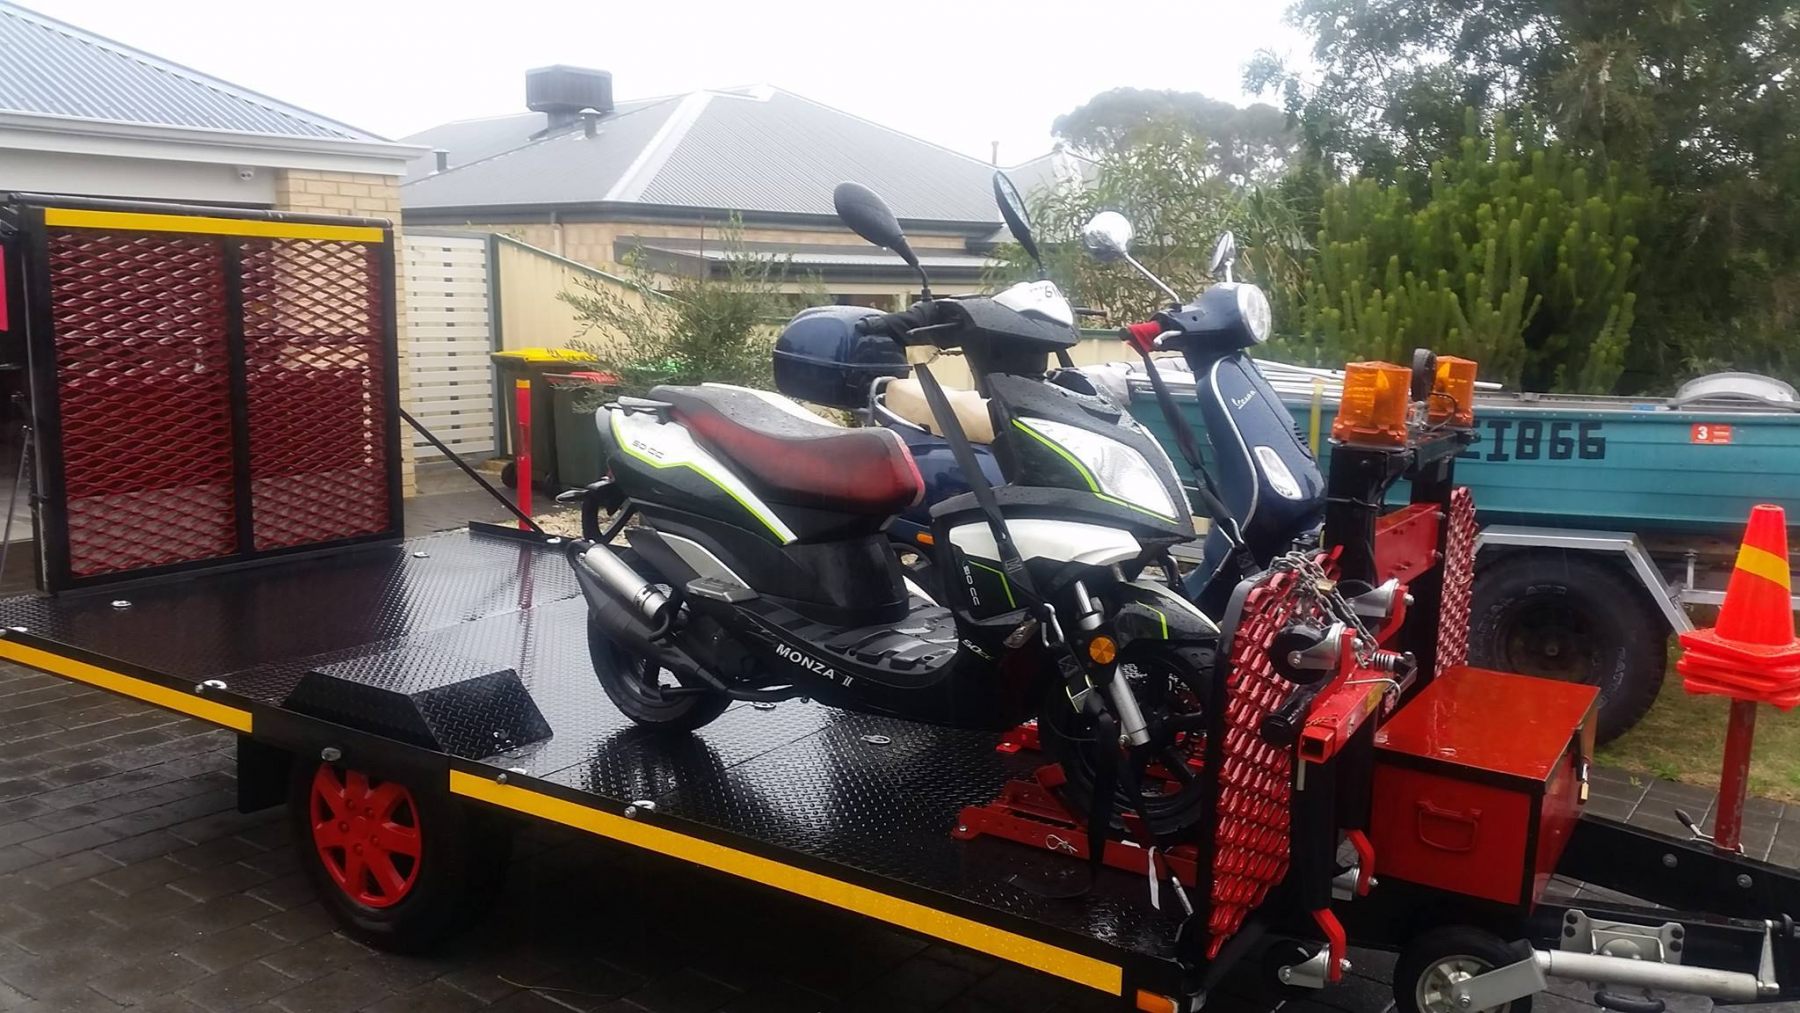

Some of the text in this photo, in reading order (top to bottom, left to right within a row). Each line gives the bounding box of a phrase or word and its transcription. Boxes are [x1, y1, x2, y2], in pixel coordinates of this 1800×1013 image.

[1698, 425, 1708, 440] 3
[963, 565, 980, 606] 50 CC
[776, 643, 854, 687] MONZA II
